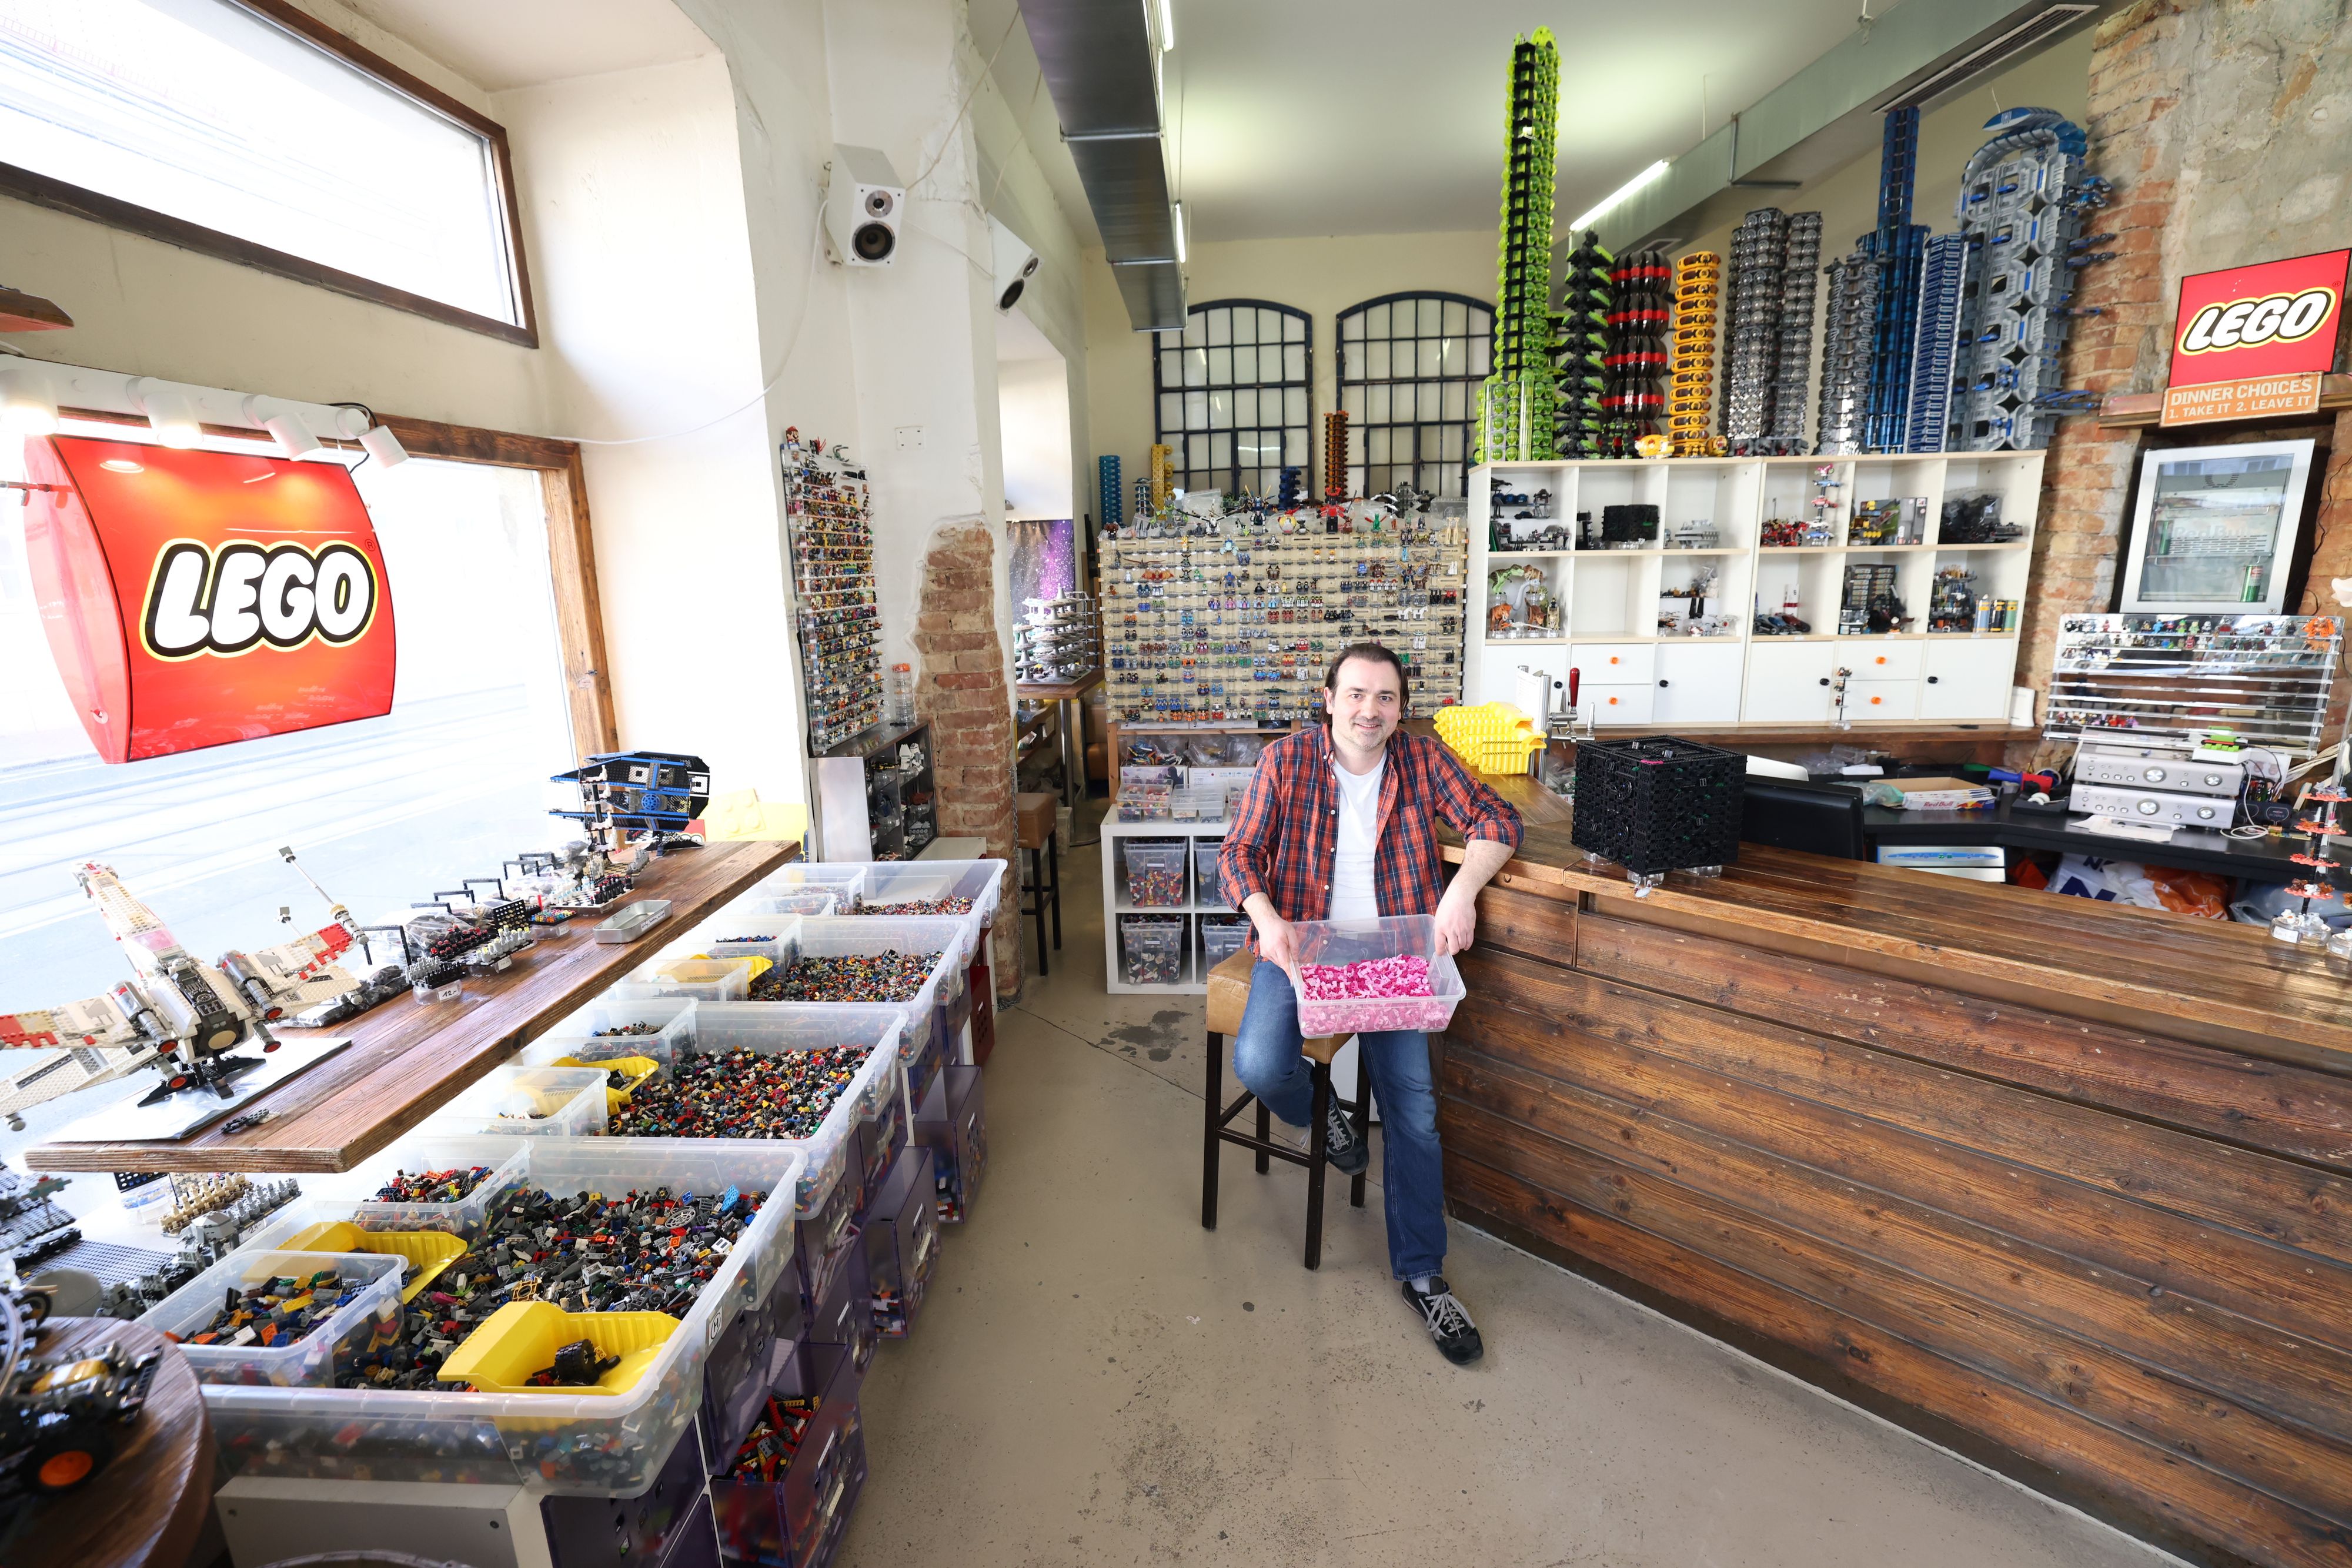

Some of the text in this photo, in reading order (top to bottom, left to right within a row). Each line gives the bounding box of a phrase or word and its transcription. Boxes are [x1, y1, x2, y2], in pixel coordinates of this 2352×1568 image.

[2183, 291, 2331, 352] LEGO
[2171, 379, 2312, 406] DINNER CHOICES
[2169, 396, 2311, 419] 1. TAKE IT 2. LEAVE IT
[145, 544, 375, 657] LEGO
[713, 1318, 719, 1332] H
